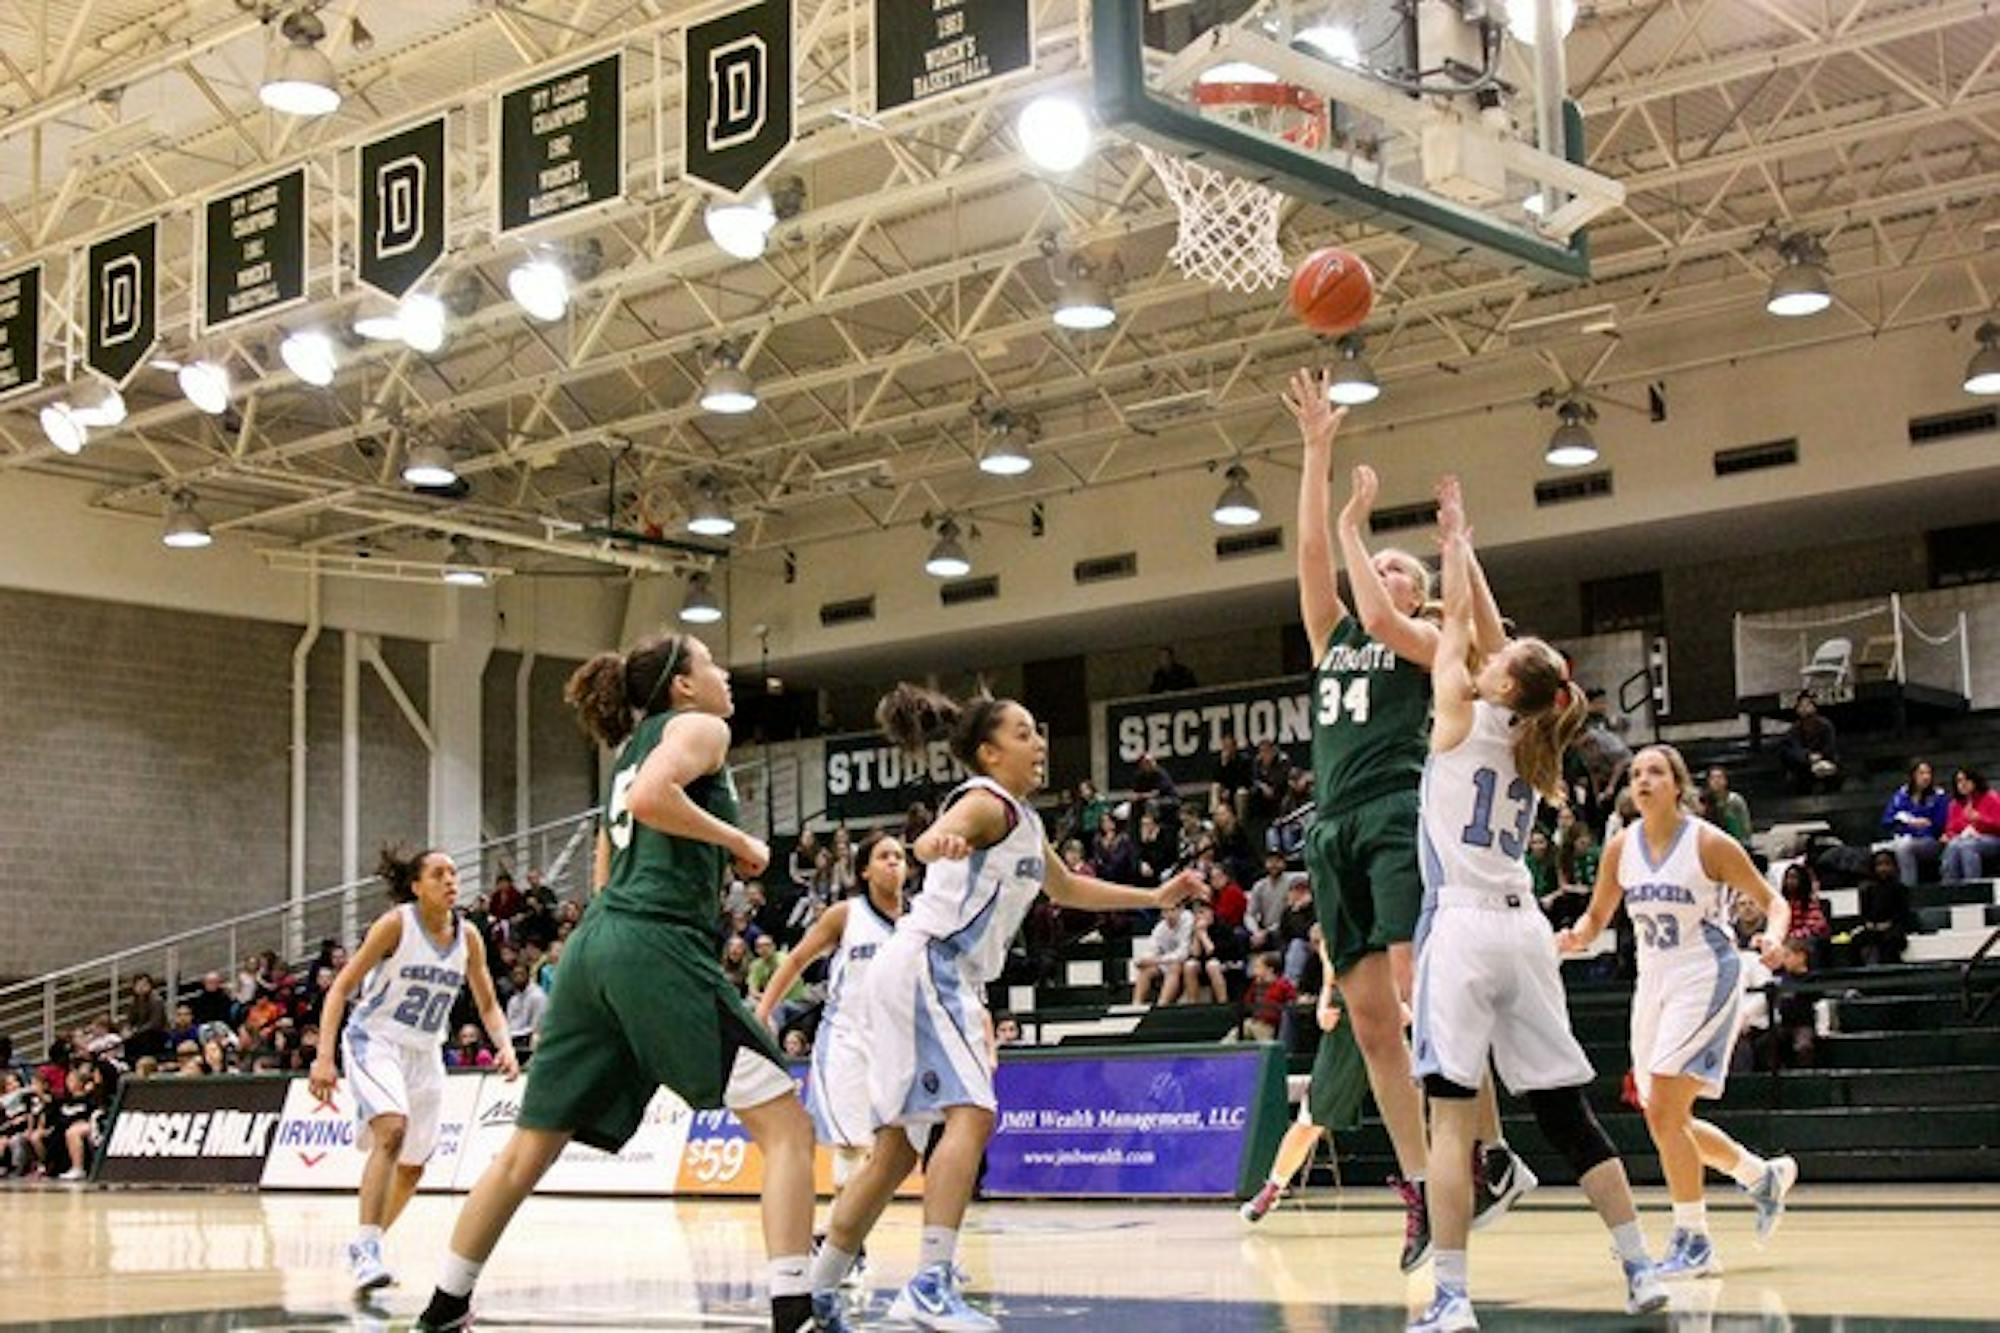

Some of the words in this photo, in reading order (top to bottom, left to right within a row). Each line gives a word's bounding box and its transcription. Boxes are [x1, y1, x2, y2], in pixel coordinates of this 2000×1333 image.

[707, 33, 768, 153] D
[913, 55, 992, 99] BASKETBALL
[376, 154, 426, 260] D
[101, 253, 142, 348] D
[1317, 677, 1370, 726] 34
[1119, 694, 1312, 763] SECTION
[827, 740, 965, 796] STUDE
[1462, 768, 1533, 861] 13
[394, 985, 451, 1032] 20
[107, 1111, 208, 1157] MUSCLE
[201, 1110, 279, 1157] MILK
[997, 1109, 1037, 1134] JMH
[1040, 1108, 1095, 1129] Wealth
[1099, 1107, 1206, 1132] Management,
[1209, 1105, 1246, 1126] LLC
[685, 1136, 746, 1182] $59
[1023, 1148, 1156, 1166] www.jmhwealth.com
